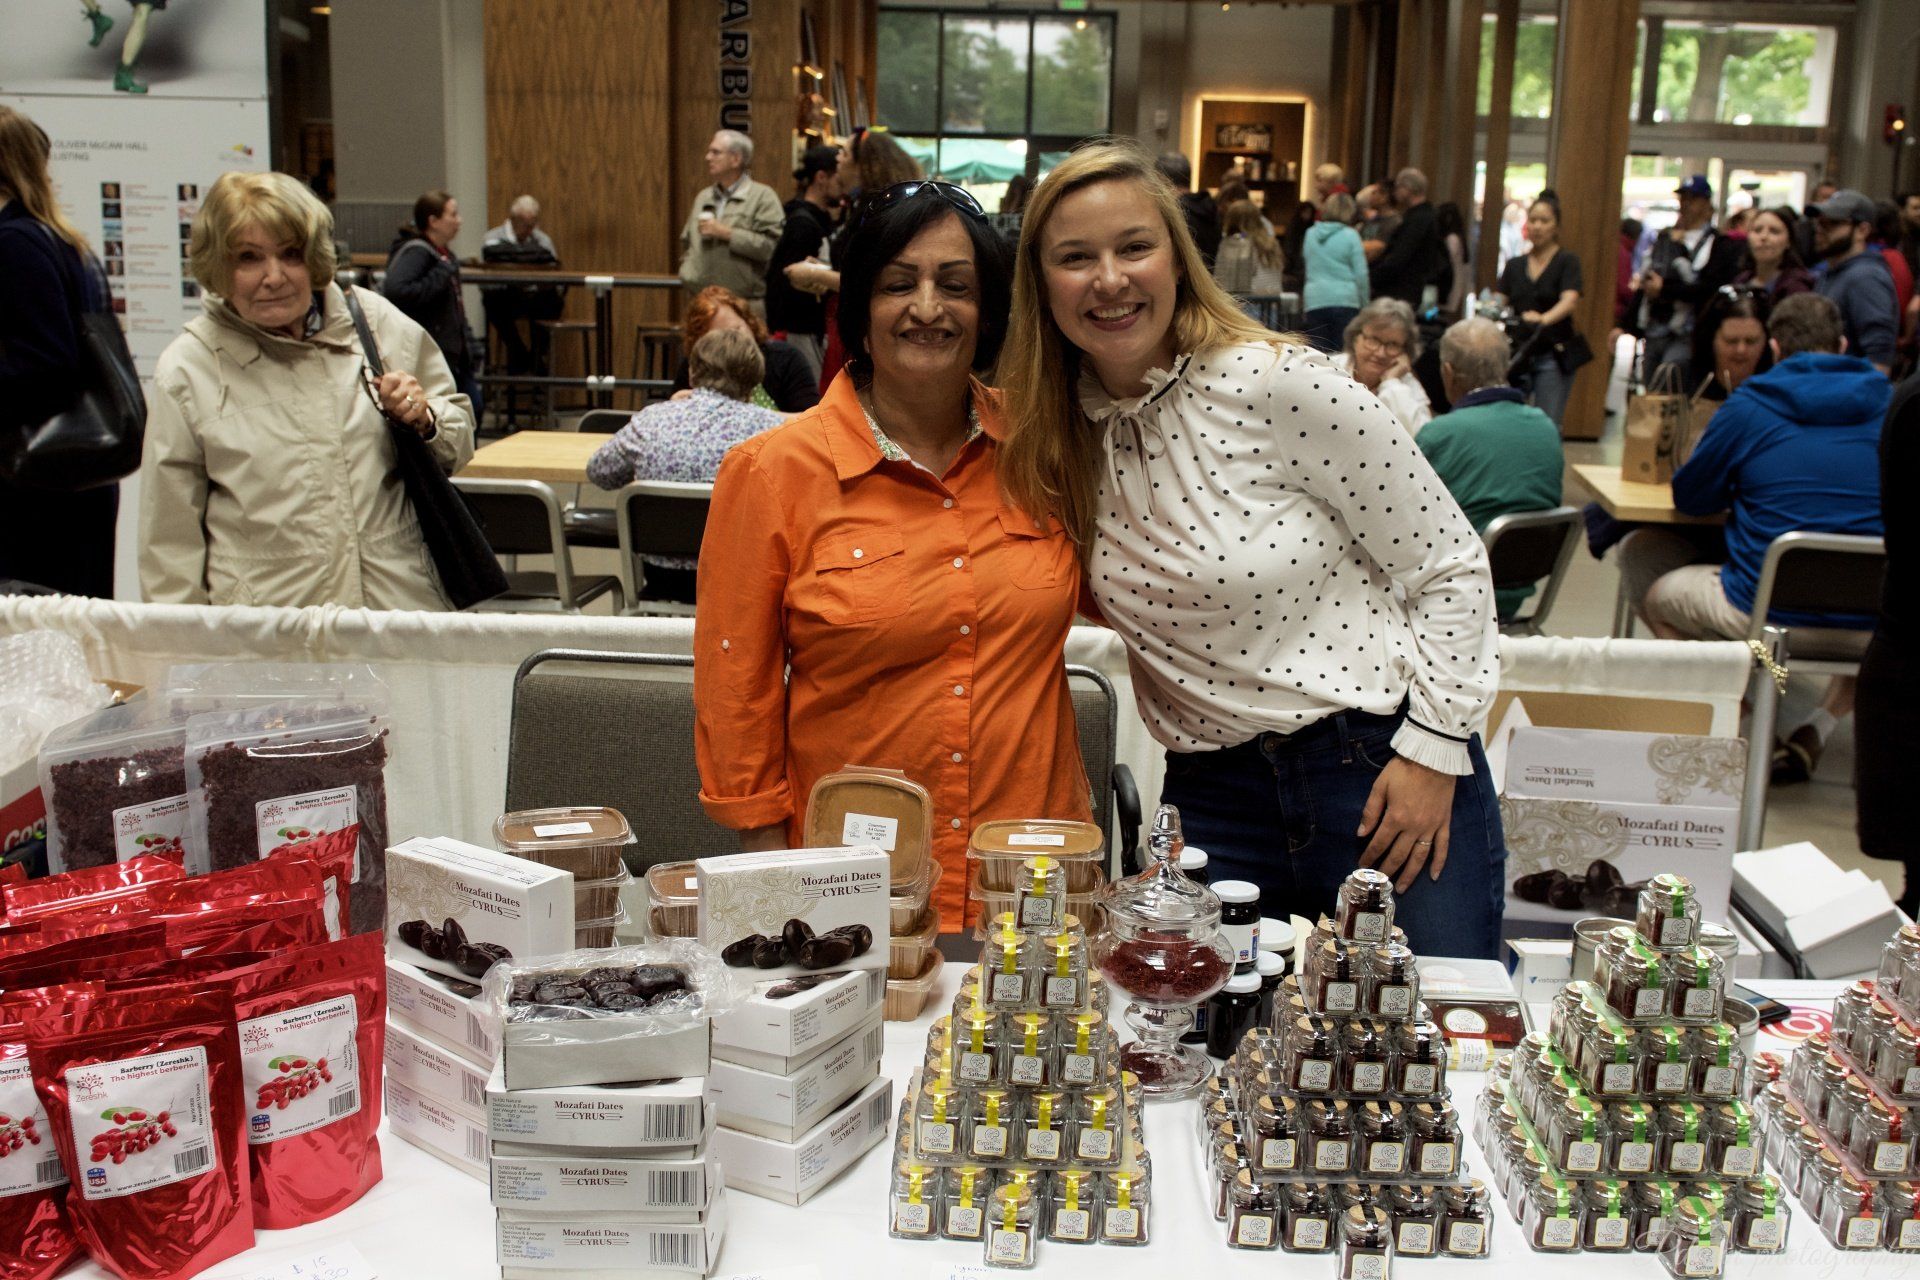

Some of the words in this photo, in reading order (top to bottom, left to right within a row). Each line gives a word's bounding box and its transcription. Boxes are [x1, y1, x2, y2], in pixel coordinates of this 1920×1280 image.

[126, 142, 148, 151] HALL
[54, 152, 89, 161] LISTING
[1544, 767, 1578, 775] CYRUS
[1525, 776, 1551, 785] Dates
[1554, 777, 1594, 787] Mozafati
[300, 802, 323, 810] highest
[323, 797, 351, 807] berberine
[156, 808, 177, 819] highest
[1617, 817, 1678, 832] Mozafati
[1683, 819, 1724, 834] Dates
[1642, 836, 1694, 849] CYRUS
[801, 874, 849, 887] Mozafati
[851, 871, 881, 883] Dates
[455, 881, 492, 900] Mozafati
[495, 892, 521, 907] Dates
[822, 885, 861, 898] CYRUS
[472, 899, 503, 916] CYRUS
[419, 987, 440, 1003] Mozafati
[441, 998, 456, 1011] Dates
[283, 1013, 312, 1025] Barberry
[313, 1003, 346, 1017] (Zereshk)
[429, 1001, 447, 1015] CYRUS
[290, 1020, 317, 1031] highest
[317, 1009, 350, 1022] berberine
[244, 1041, 274, 1055] Zereshk
[413, 1044, 435, 1061] Mozafati
[436, 1056, 451, 1069] Dates
[0, 1066, 22, 1075] berry
[120, 1063, 154, 1074] Barberry
[156, 1055, 193, 1068] (Zereshk)
[421, 1058, 441, 1073] CYRUS
[110, 1075, 126, 1083] The
[127, 1069, 158, 1081] highest
[159, 1061, 199, 1073] berberine
[968, 1071, 988, 1079] Saffron
[75, 1091, 108, 1103] Zereshk
[554, 1101, 594, 1110] Mozafati
[597, 1102, 623, 1110] Dates
[419, 1101, 440, 1117] Mozafati
[441, 1111, 456, 1124] Dates
[572, 1112, 605, 1120] CYRUS
[427, 1114, 446, 1129] CYRUS
[560, 1167, 599, 1176] Mozafati
[602, 1168, 628, 1176] Dates
[88, 1178, 106, 1186] USA
[116, 1174, 171, 1192] www.zereshk.com
[577, 1178, 610, 1186] CYRUS
[562, 1228, 601, 1237] Mozafati
[604, 1229, 630, 1237] Dates
